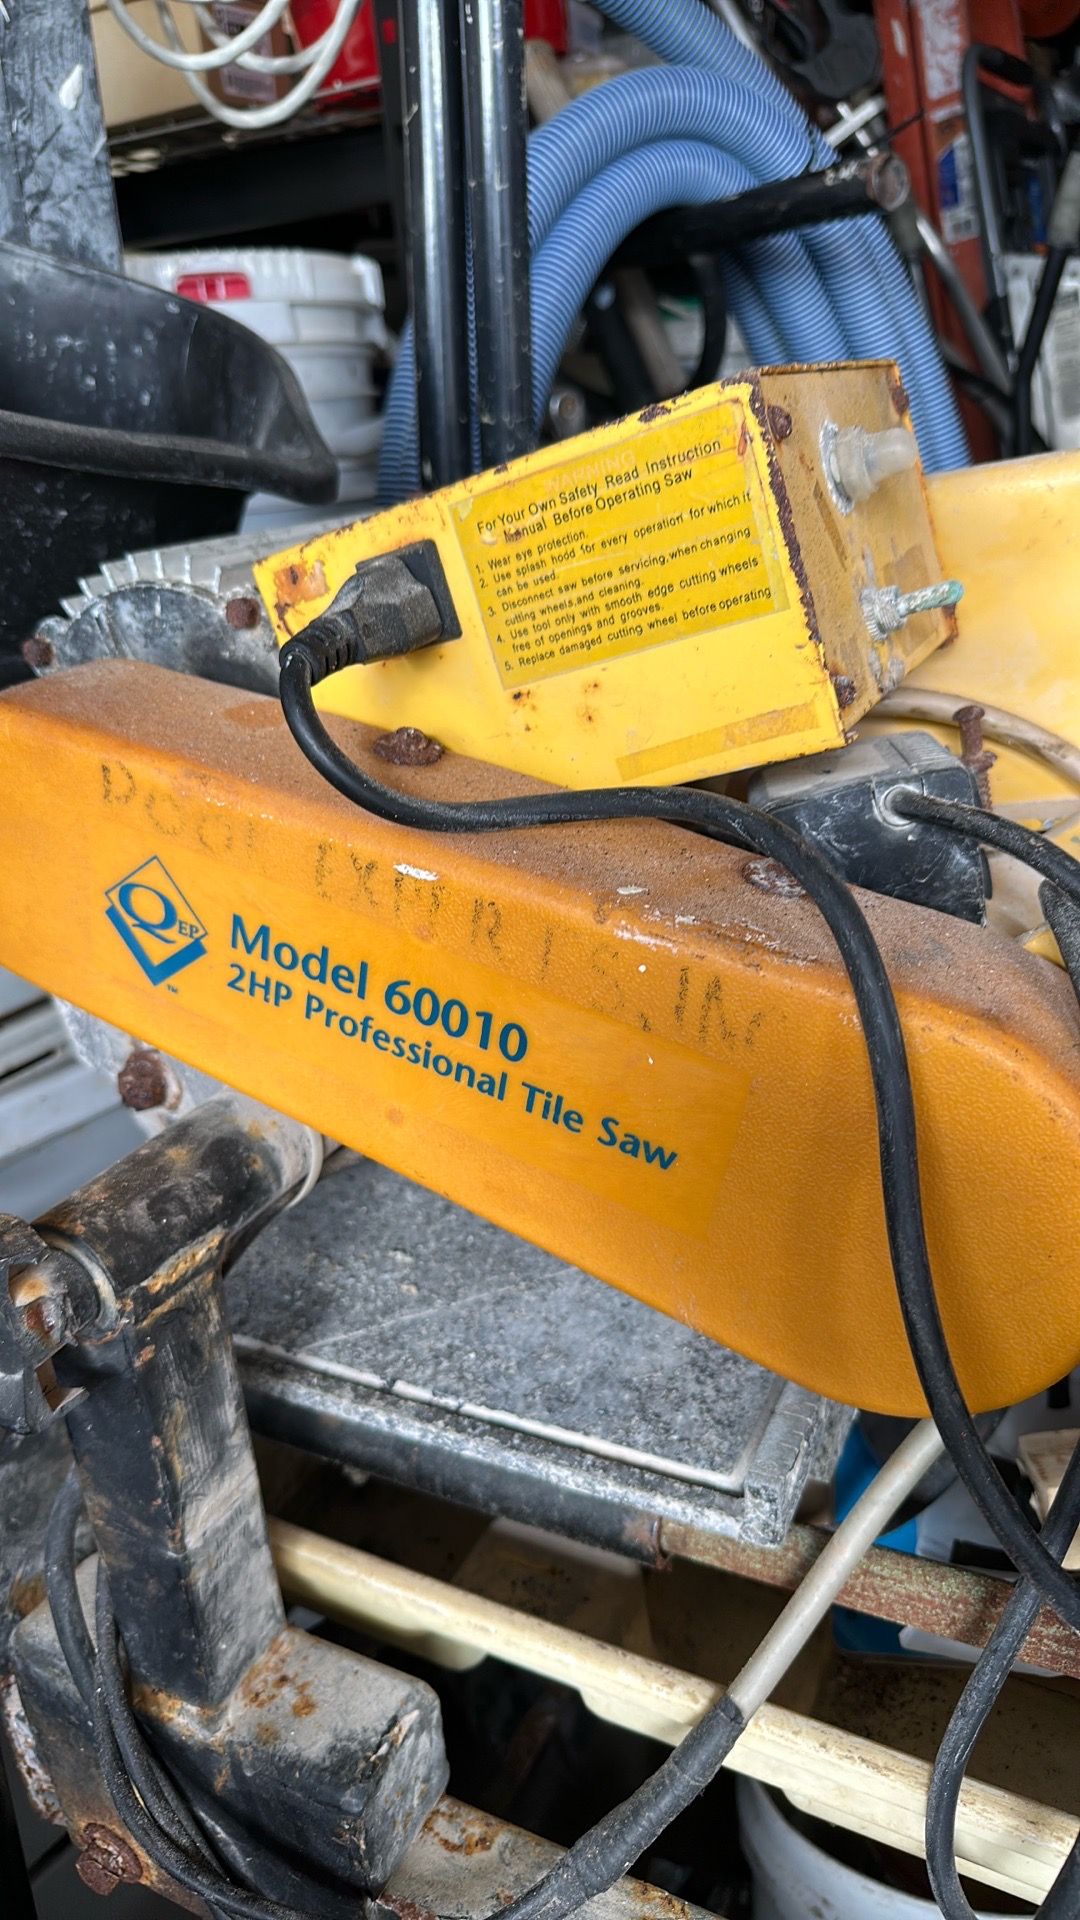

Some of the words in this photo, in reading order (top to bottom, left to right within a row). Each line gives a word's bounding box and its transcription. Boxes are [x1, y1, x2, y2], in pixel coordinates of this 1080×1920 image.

[477, 520, 496, 534] For
[498, 509, 526, 525] Your
[528, 499, 557, 516] Own
[559, 483, 598, 504] Safety
[605, 466, 639, 489] Read
[646, 440, 721, 474] Instruction
[504, 516, 547, 543] Manual
[553, 503, 593, 525] Before
[596, 478, 661, 511] Operating
[664, 469, 693, 487] Saw
[480, 578, 489, 589] 2.
[493, 571, 512, 583] Use
[516, 559, 547, 577] splash
[580, 543, 596, 554] for
[601, 533, 628, 549] every
[633, 513, 684, 539] operation
[689, 507, 706, 520] for
[707, 494, 741, 514] which
[743, 491, 752, 502] it
[488, 555, 511, 570] Wear
[516, 549, 533, 562] eye
[488, 606, 496, 617] 3.
[502, 588, 554, 612] Disconnect
[558, 582, 577, 593] saw
[581, 568, 614, 586] before
[669, 544, 698, 560] when
[700, 526, 751, 550] changing
[496, 587, 513, 598] can
[517, 580, 529, 590] be
[505, 610, 536, 627] cutting
[576, 592, 594, 604] and
[510, 628, 529, 640] Use
[533, 620, 551, 632] tool
[555, 613, 576, 626] only
[580, 605, 601, 619] with
[605, 592, 642, 612] smooth
[648, 583, 674, 599] edge
[680, 569, 716, 589] cutting
[719, 556, 759, 577] wheels
[518, 650, 555, 667] Replace
[559, 635, 603, 655] damaged
[607, 624, 643, 641] cutting
[647, 613, 678, 630] wheel
[682, 601, 717, 620] before
[719, 587, 772, 610] operating
[512, 641, 531, 653] free
[535, 635, 545, 647] of
[548, 622, 593, 644] openings
[597, 615, 615, 628] and
[230, 913, 368, 1000] Model
[384, 979, 528, 1062] 60010
[227, 963, 293, 1006] 2HP
[305, 990, 508, 1101] Professional
[521, 1081, 583, 1133] Tile
[597, 1117, 678, 1170] Saw
